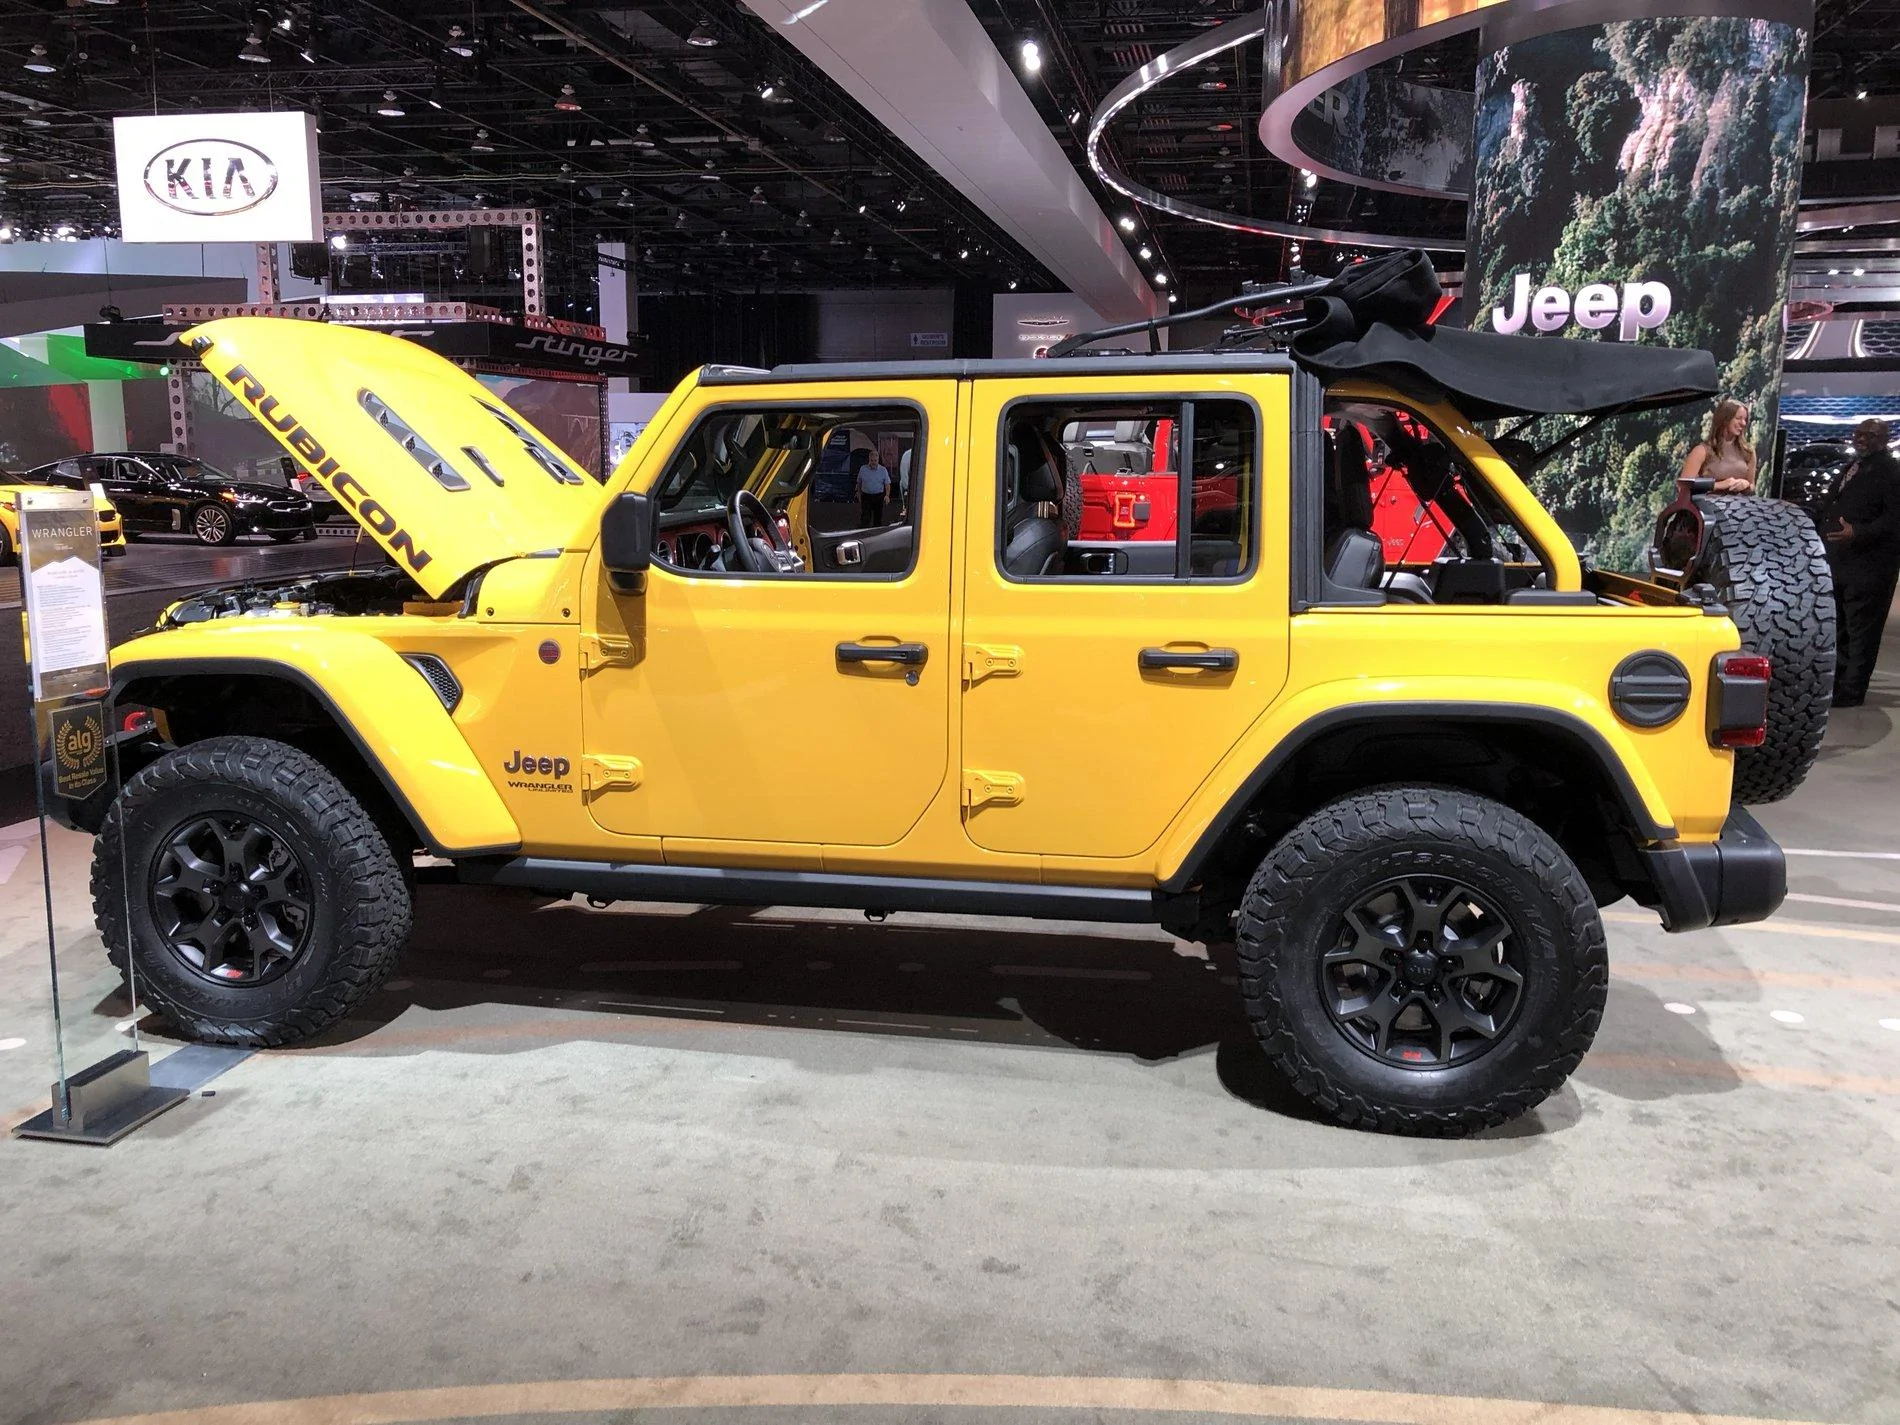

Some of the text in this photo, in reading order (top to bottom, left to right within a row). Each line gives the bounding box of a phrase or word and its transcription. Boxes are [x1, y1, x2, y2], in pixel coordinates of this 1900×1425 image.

[165, 157, 256, 200] KIA
[1492, 272, 1672, 341] Jeep
[514, 334, 639, 366] stinger
[225, 364, 433, 573] RUBICON
[31, 525, 93, 539] WRANGLER
[67, 729, 93, 754] alg
[503, 749, 571, 780] Jeep
[507, 780, 573, 790] WRANGLER
